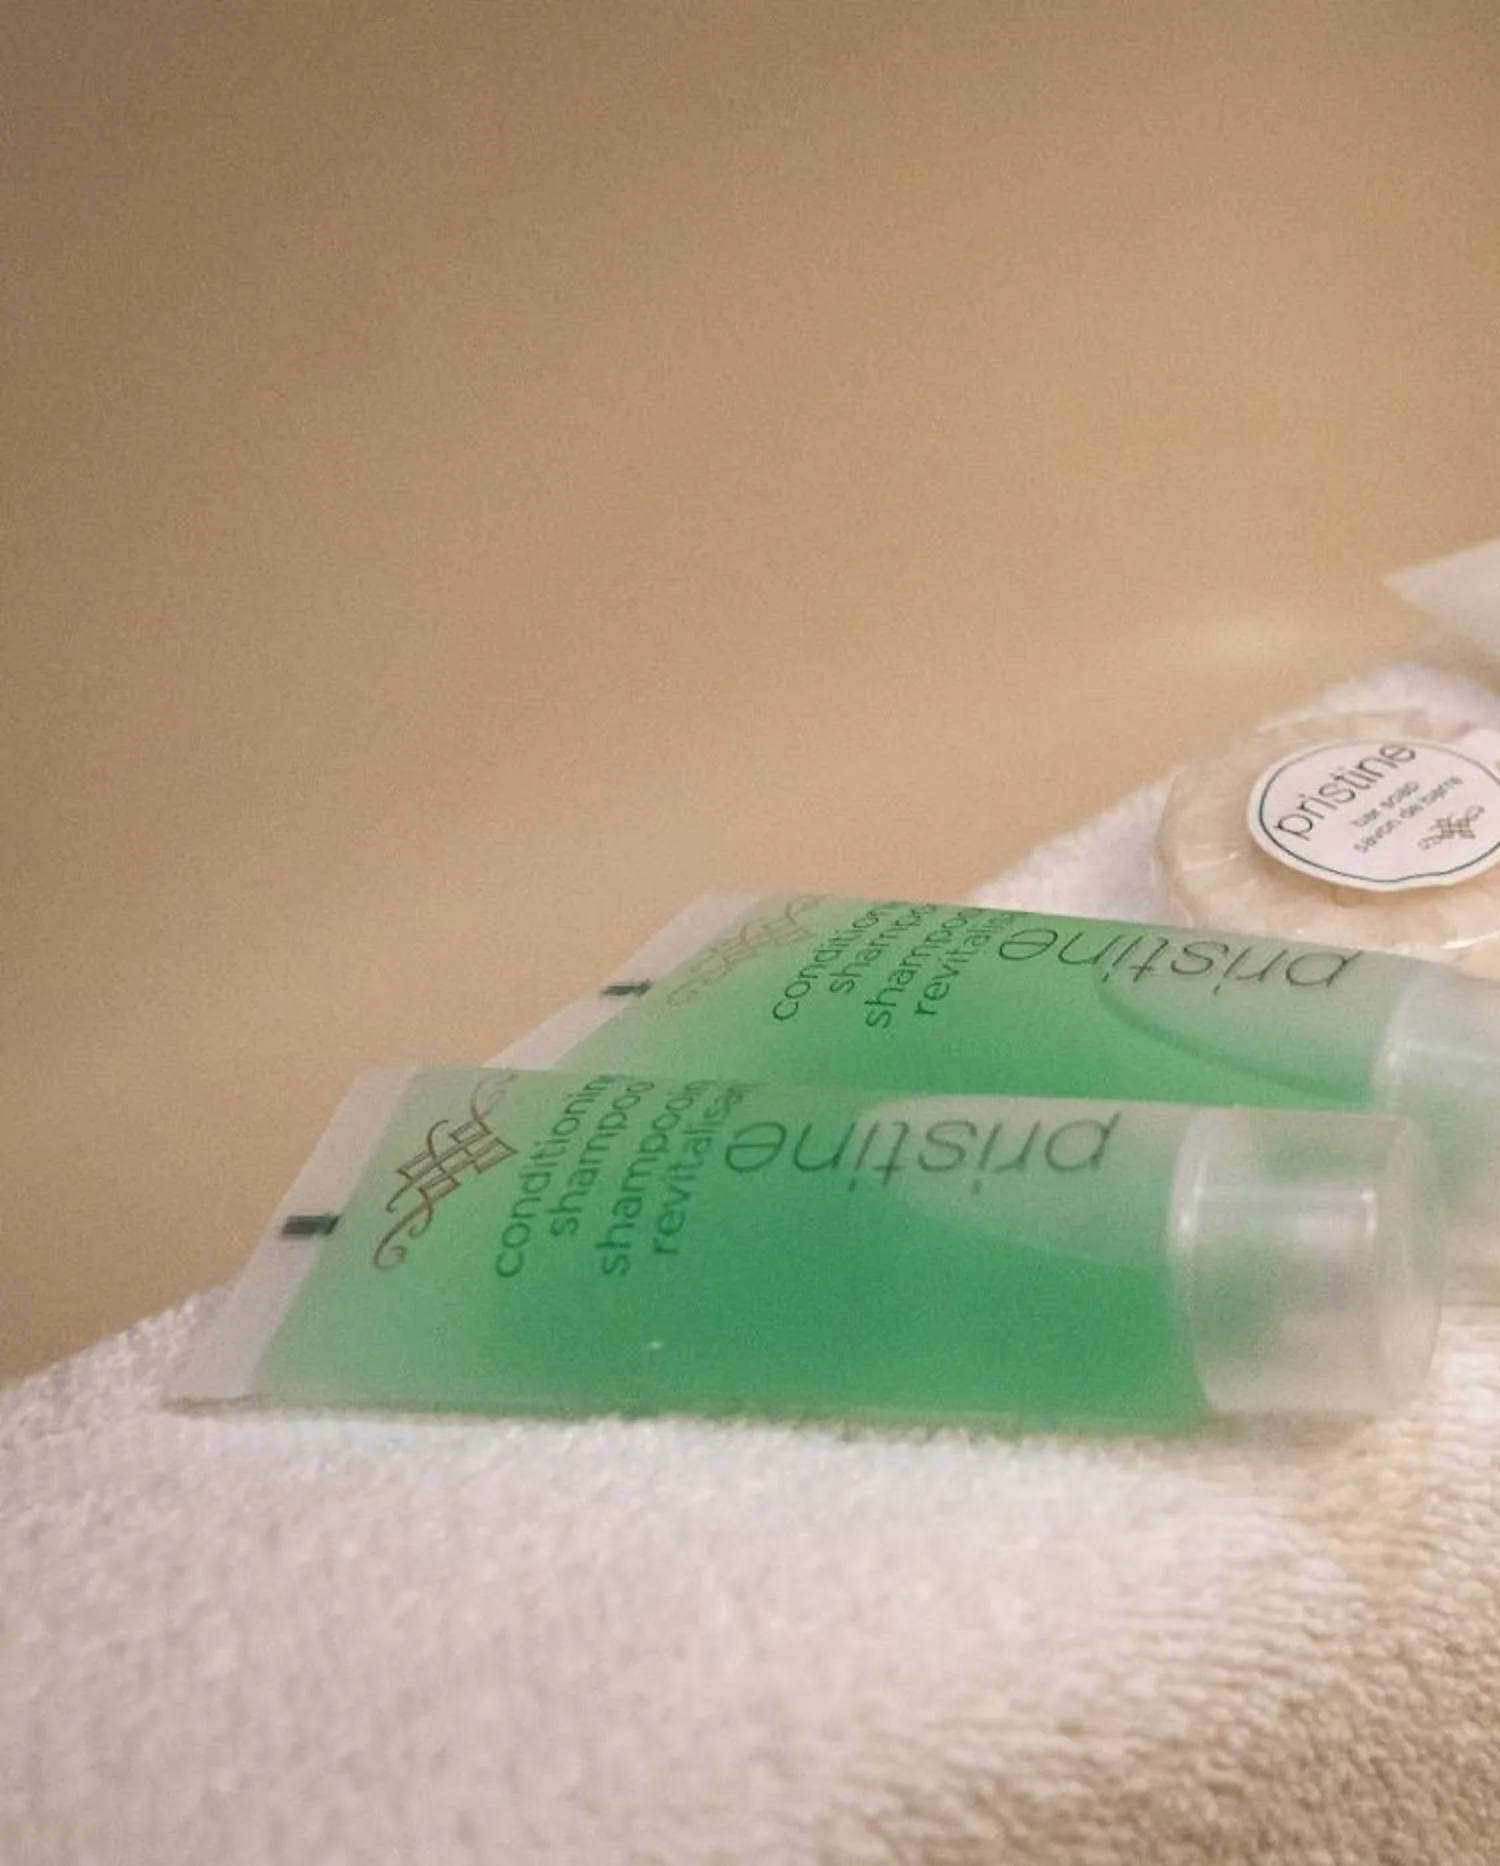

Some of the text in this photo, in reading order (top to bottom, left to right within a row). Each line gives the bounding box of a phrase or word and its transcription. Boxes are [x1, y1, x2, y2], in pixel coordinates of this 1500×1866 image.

[1273, 742, 1417, 842] pristine
[999, 927, 1365, 997] pristine
[548, 1081, 657, 1238] shampoo
[725, 1111, 1123, 1195] pristine
